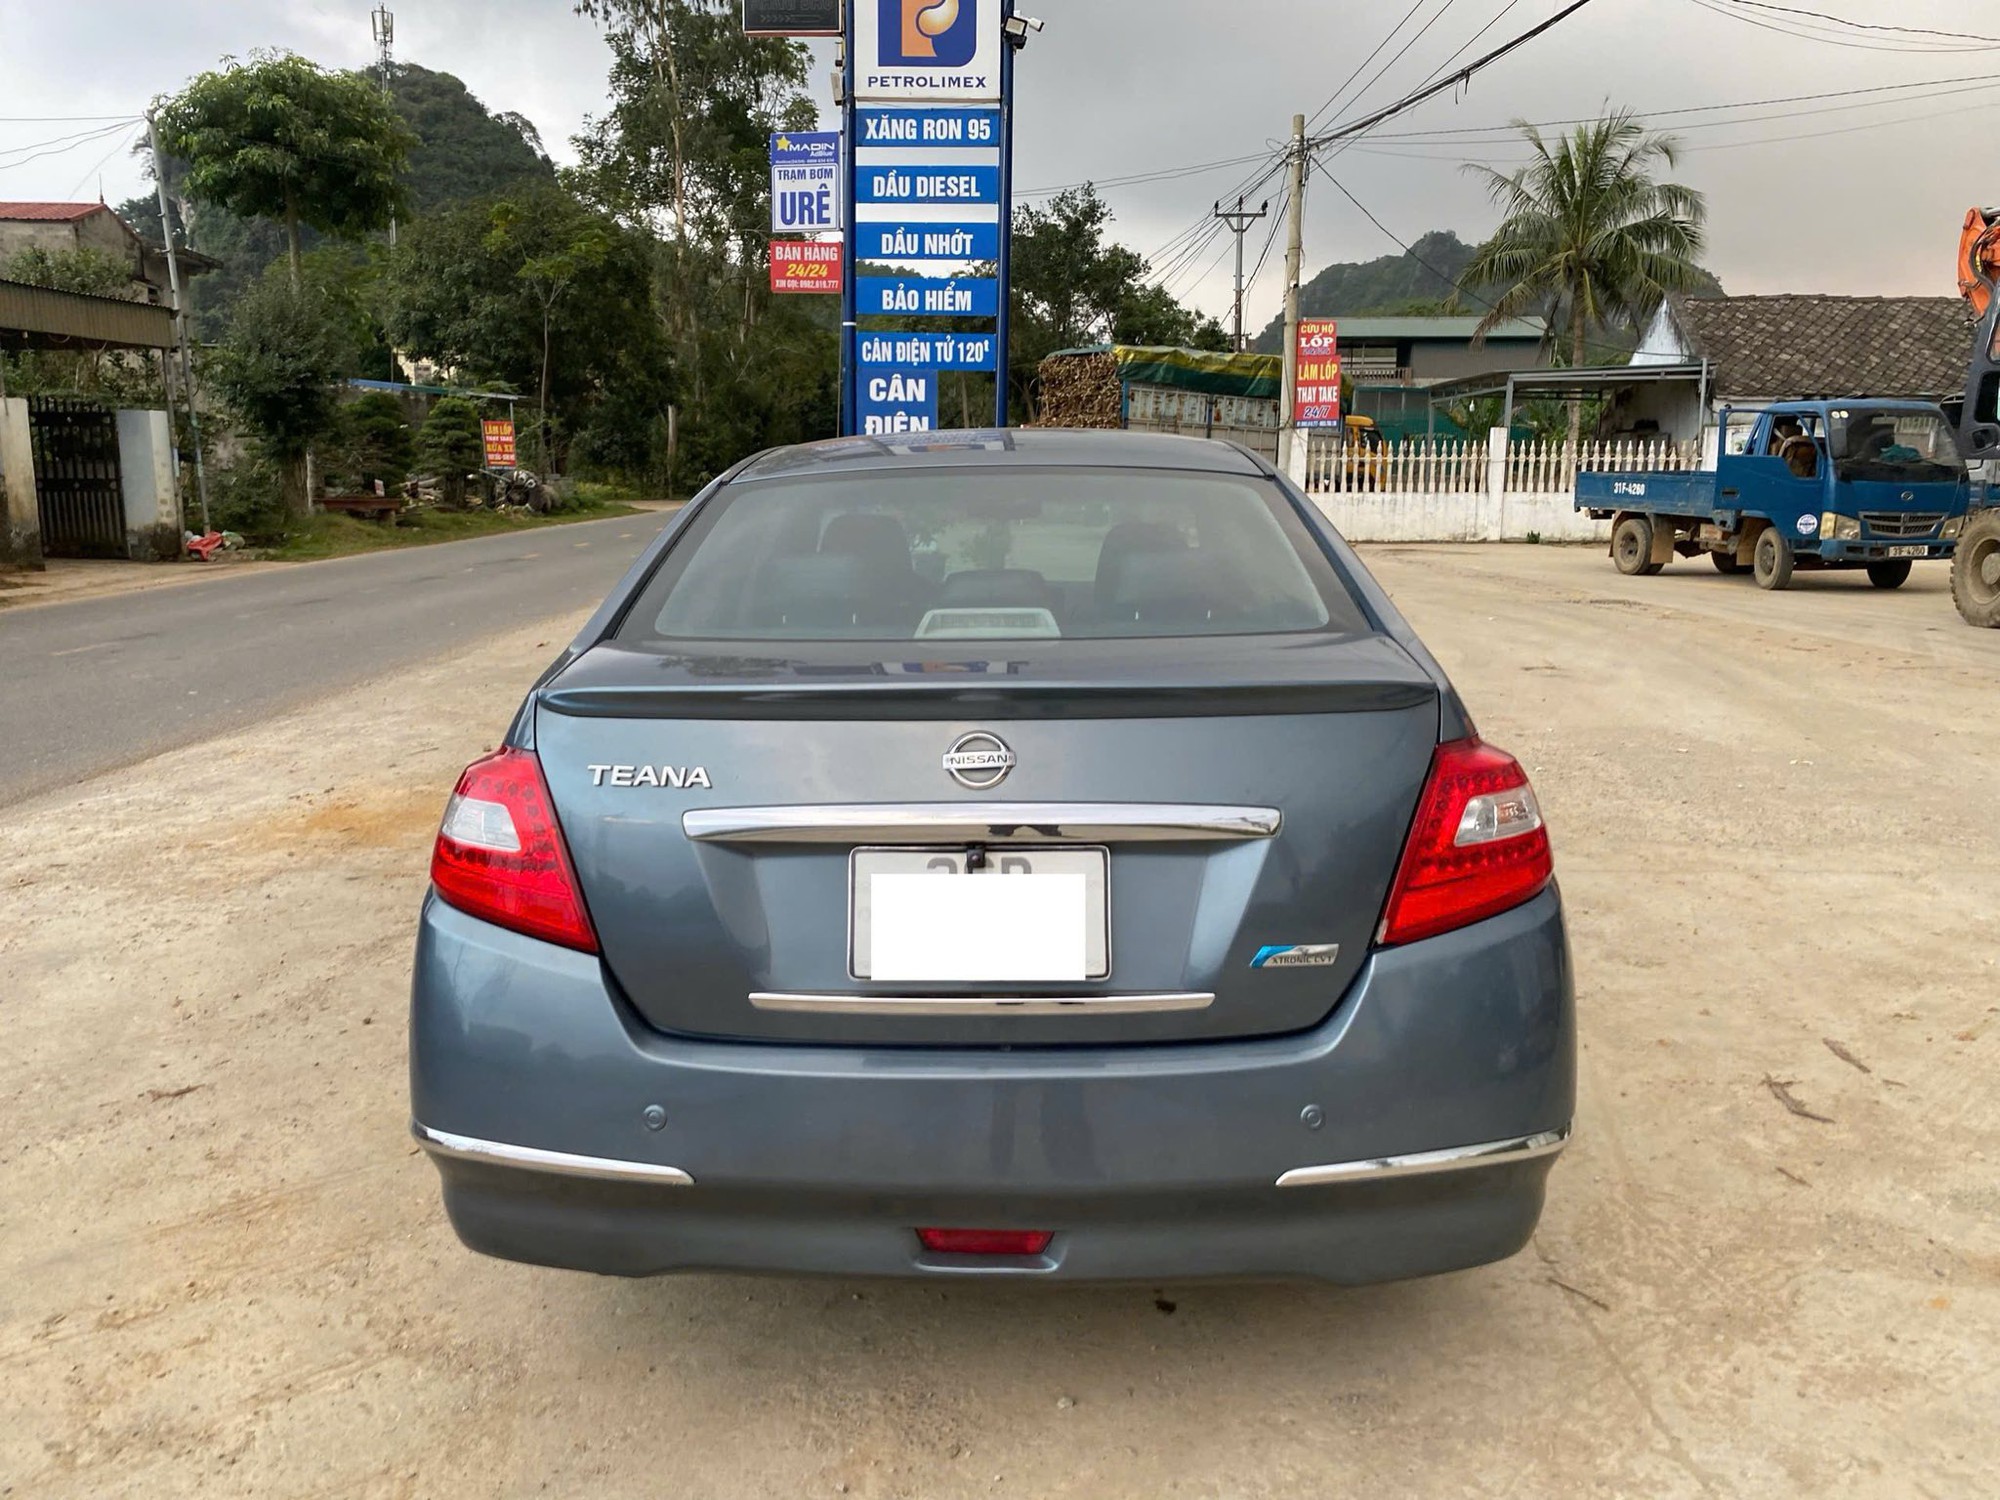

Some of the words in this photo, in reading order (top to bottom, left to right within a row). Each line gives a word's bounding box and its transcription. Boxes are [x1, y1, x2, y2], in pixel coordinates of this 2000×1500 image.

[868, 76, 986, 88] PETROLIMEX
[865, 114, 917, 140] XĂNG
[923, 119, 962, 140] RON
[968, 118, 990, 140] 95
[790, 143, 835, 151] MADIN
[777, 169, 806, 183] TRẠM
[810, 168, 833, 179] BƠM
[873, 169, 911, 197] DẦU
[916, 176, 981, 197] DIESEL
[780, 183, 831, 225] URÊ
[881, 226, 919, 255] DẦU
[924, 228, 974, 255] NHỚT
[775, 243, 801, 260] BÁN
[804, 244, 838, 261] HÀNG
[785, 263, 828, 277] 24/24
[882, 283, 919, 310] BẢO
[925, 281, 972, 311] HIỂM
[862, 337, 892, 362] CÂN
[896, 338, 930, 366] ĐIỆN
[935, 334, 955, 362] TỬ
[1300, 332, 1334, 348] LỐP
[1298, 361, 1318, 380] LÀM
[1321, 359, 1338, 380] LỐP
[869, 373, 926, 402] CÂN
[1297, 387, 1317, 403] THAY
[1319, 386, 1338, 402] TAKE
[950, 754, 1008, 765] NISSAN
[587, 764, 713, 789] TEANA
